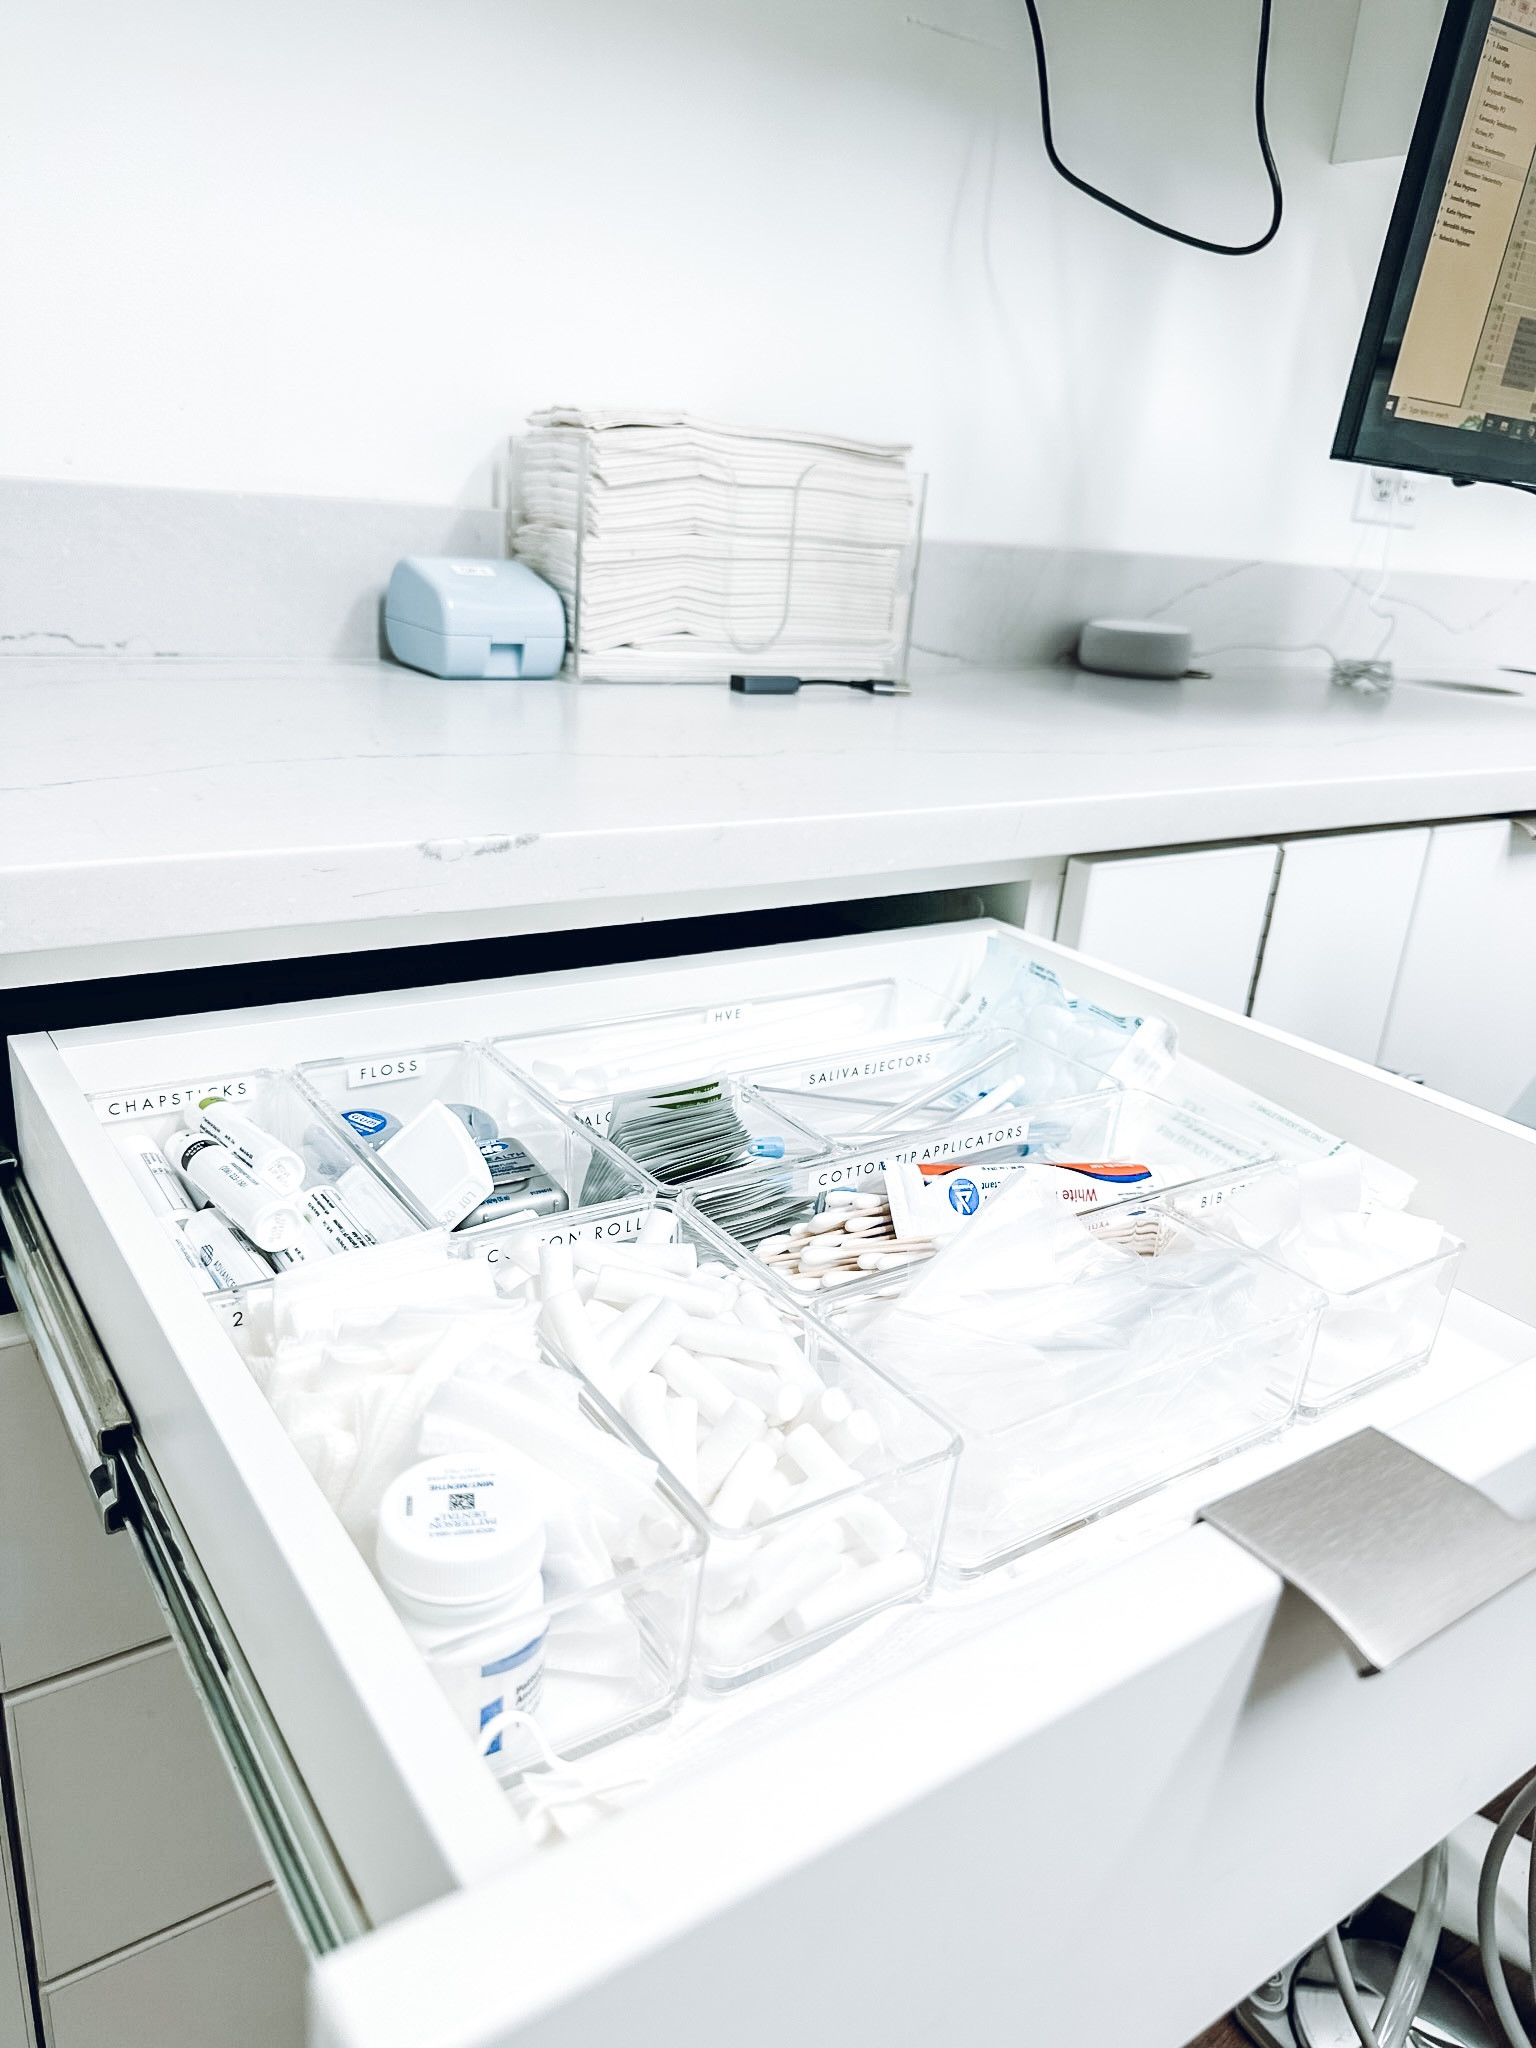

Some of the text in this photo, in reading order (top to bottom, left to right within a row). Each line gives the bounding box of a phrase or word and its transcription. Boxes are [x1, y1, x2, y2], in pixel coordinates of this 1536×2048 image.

[714, 1008, 742, 1023] HVE
[360, 1060, 418, 1080] FLOSS
[808, 1053, 932, 1085] SALIVA EJECTORS
[108, 1082, 247, 1116] CHAPSTKS
[585, 1111, 612, 1126] ALC
[896, 1151, 918, 1165] TIP
[922, 1125, 1023, 1161] APPLICATORS
[485, 1151, 527, 1162] EALTH
[1062, 1188, 1098, 1202] White
[1200, 1191, 1223, 1208] BIB
[232, 1311, 244, 1328] 2
